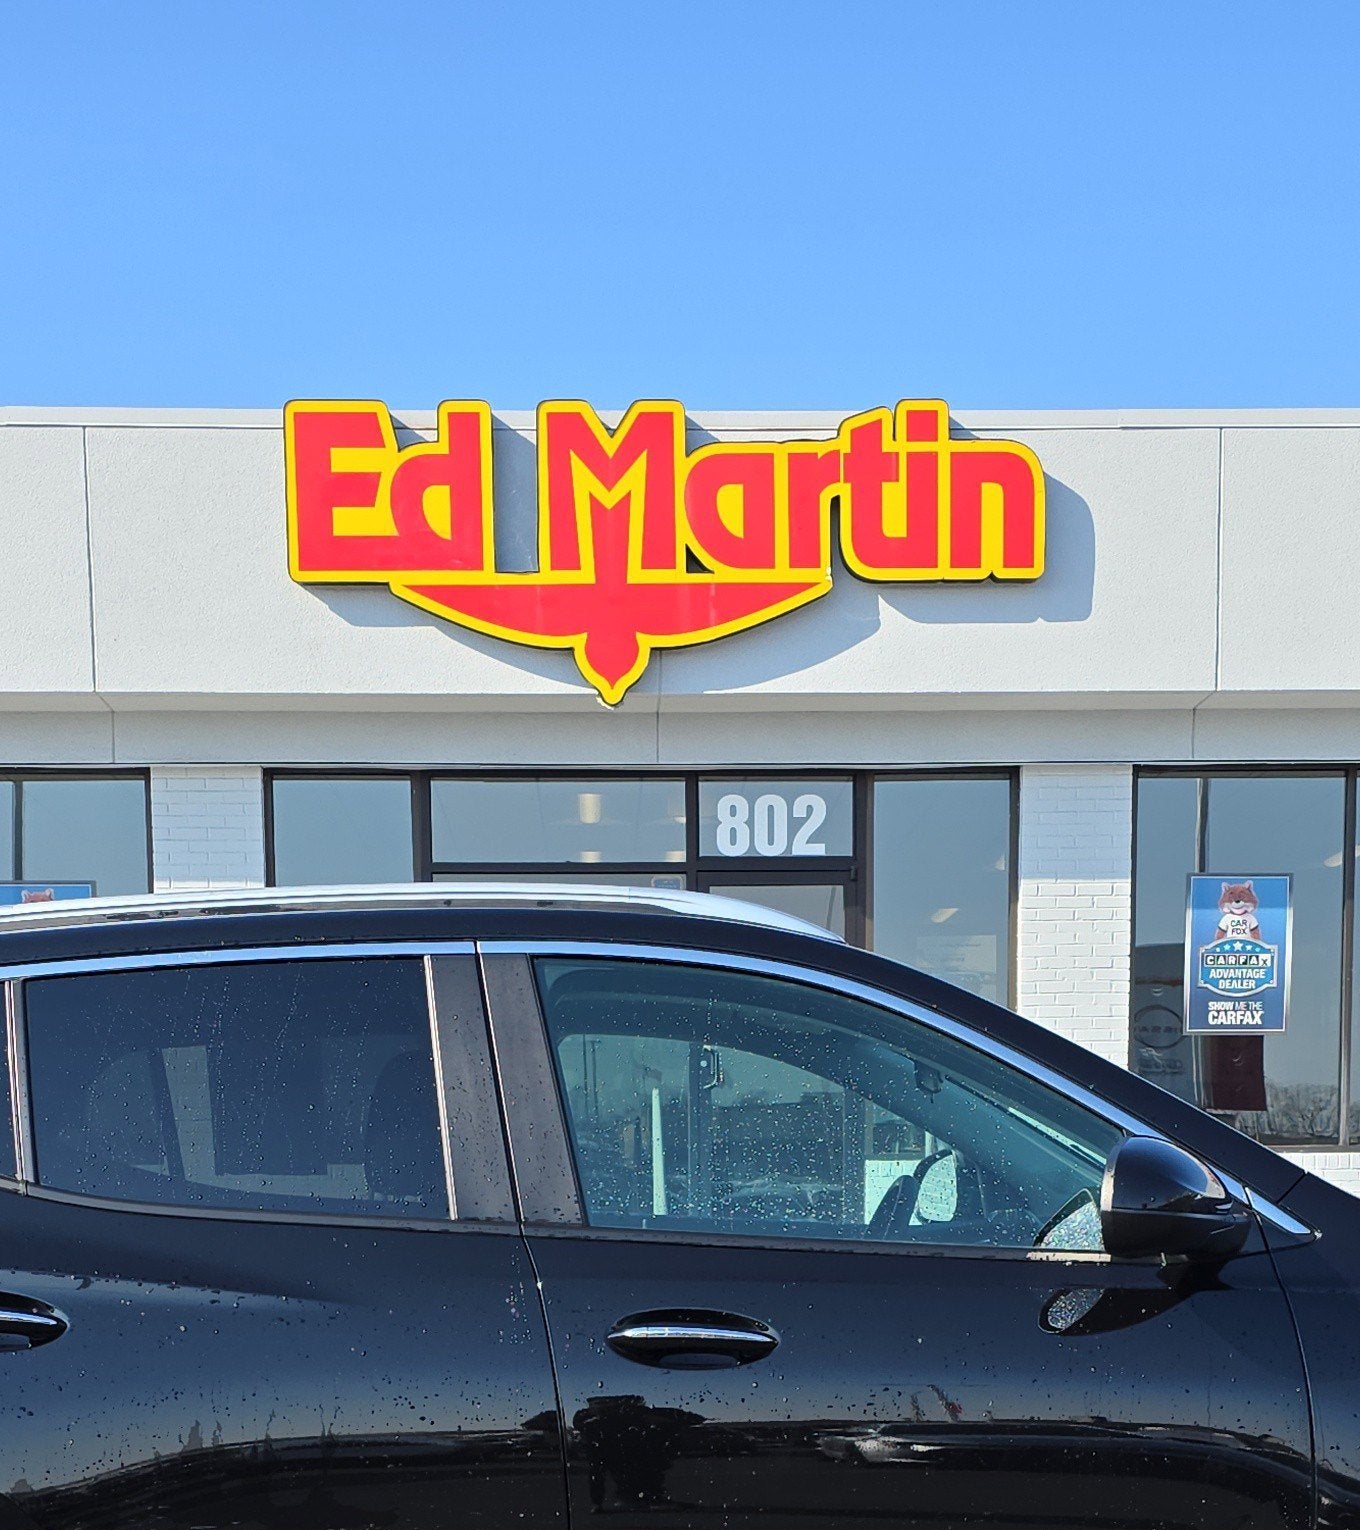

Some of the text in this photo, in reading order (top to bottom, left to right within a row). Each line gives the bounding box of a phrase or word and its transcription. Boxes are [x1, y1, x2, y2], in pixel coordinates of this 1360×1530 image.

[287, 401, 1043, 581] Ed Martin
[716, 794, 827, 857] 802
[1230, 919, 1248, 928] CAR
[1231, 927, 1248, 935] FOX
[1205, 954, 1271, 967] CARFAX
[1209, 968, 1266, 979] ADVANTAGE
[1218, 979, 1256, 989] DEALER
[1208, 1001, 1263, 1011] SHOW ME THE
[1208, 1010, 1263, 1025] CARFAX
